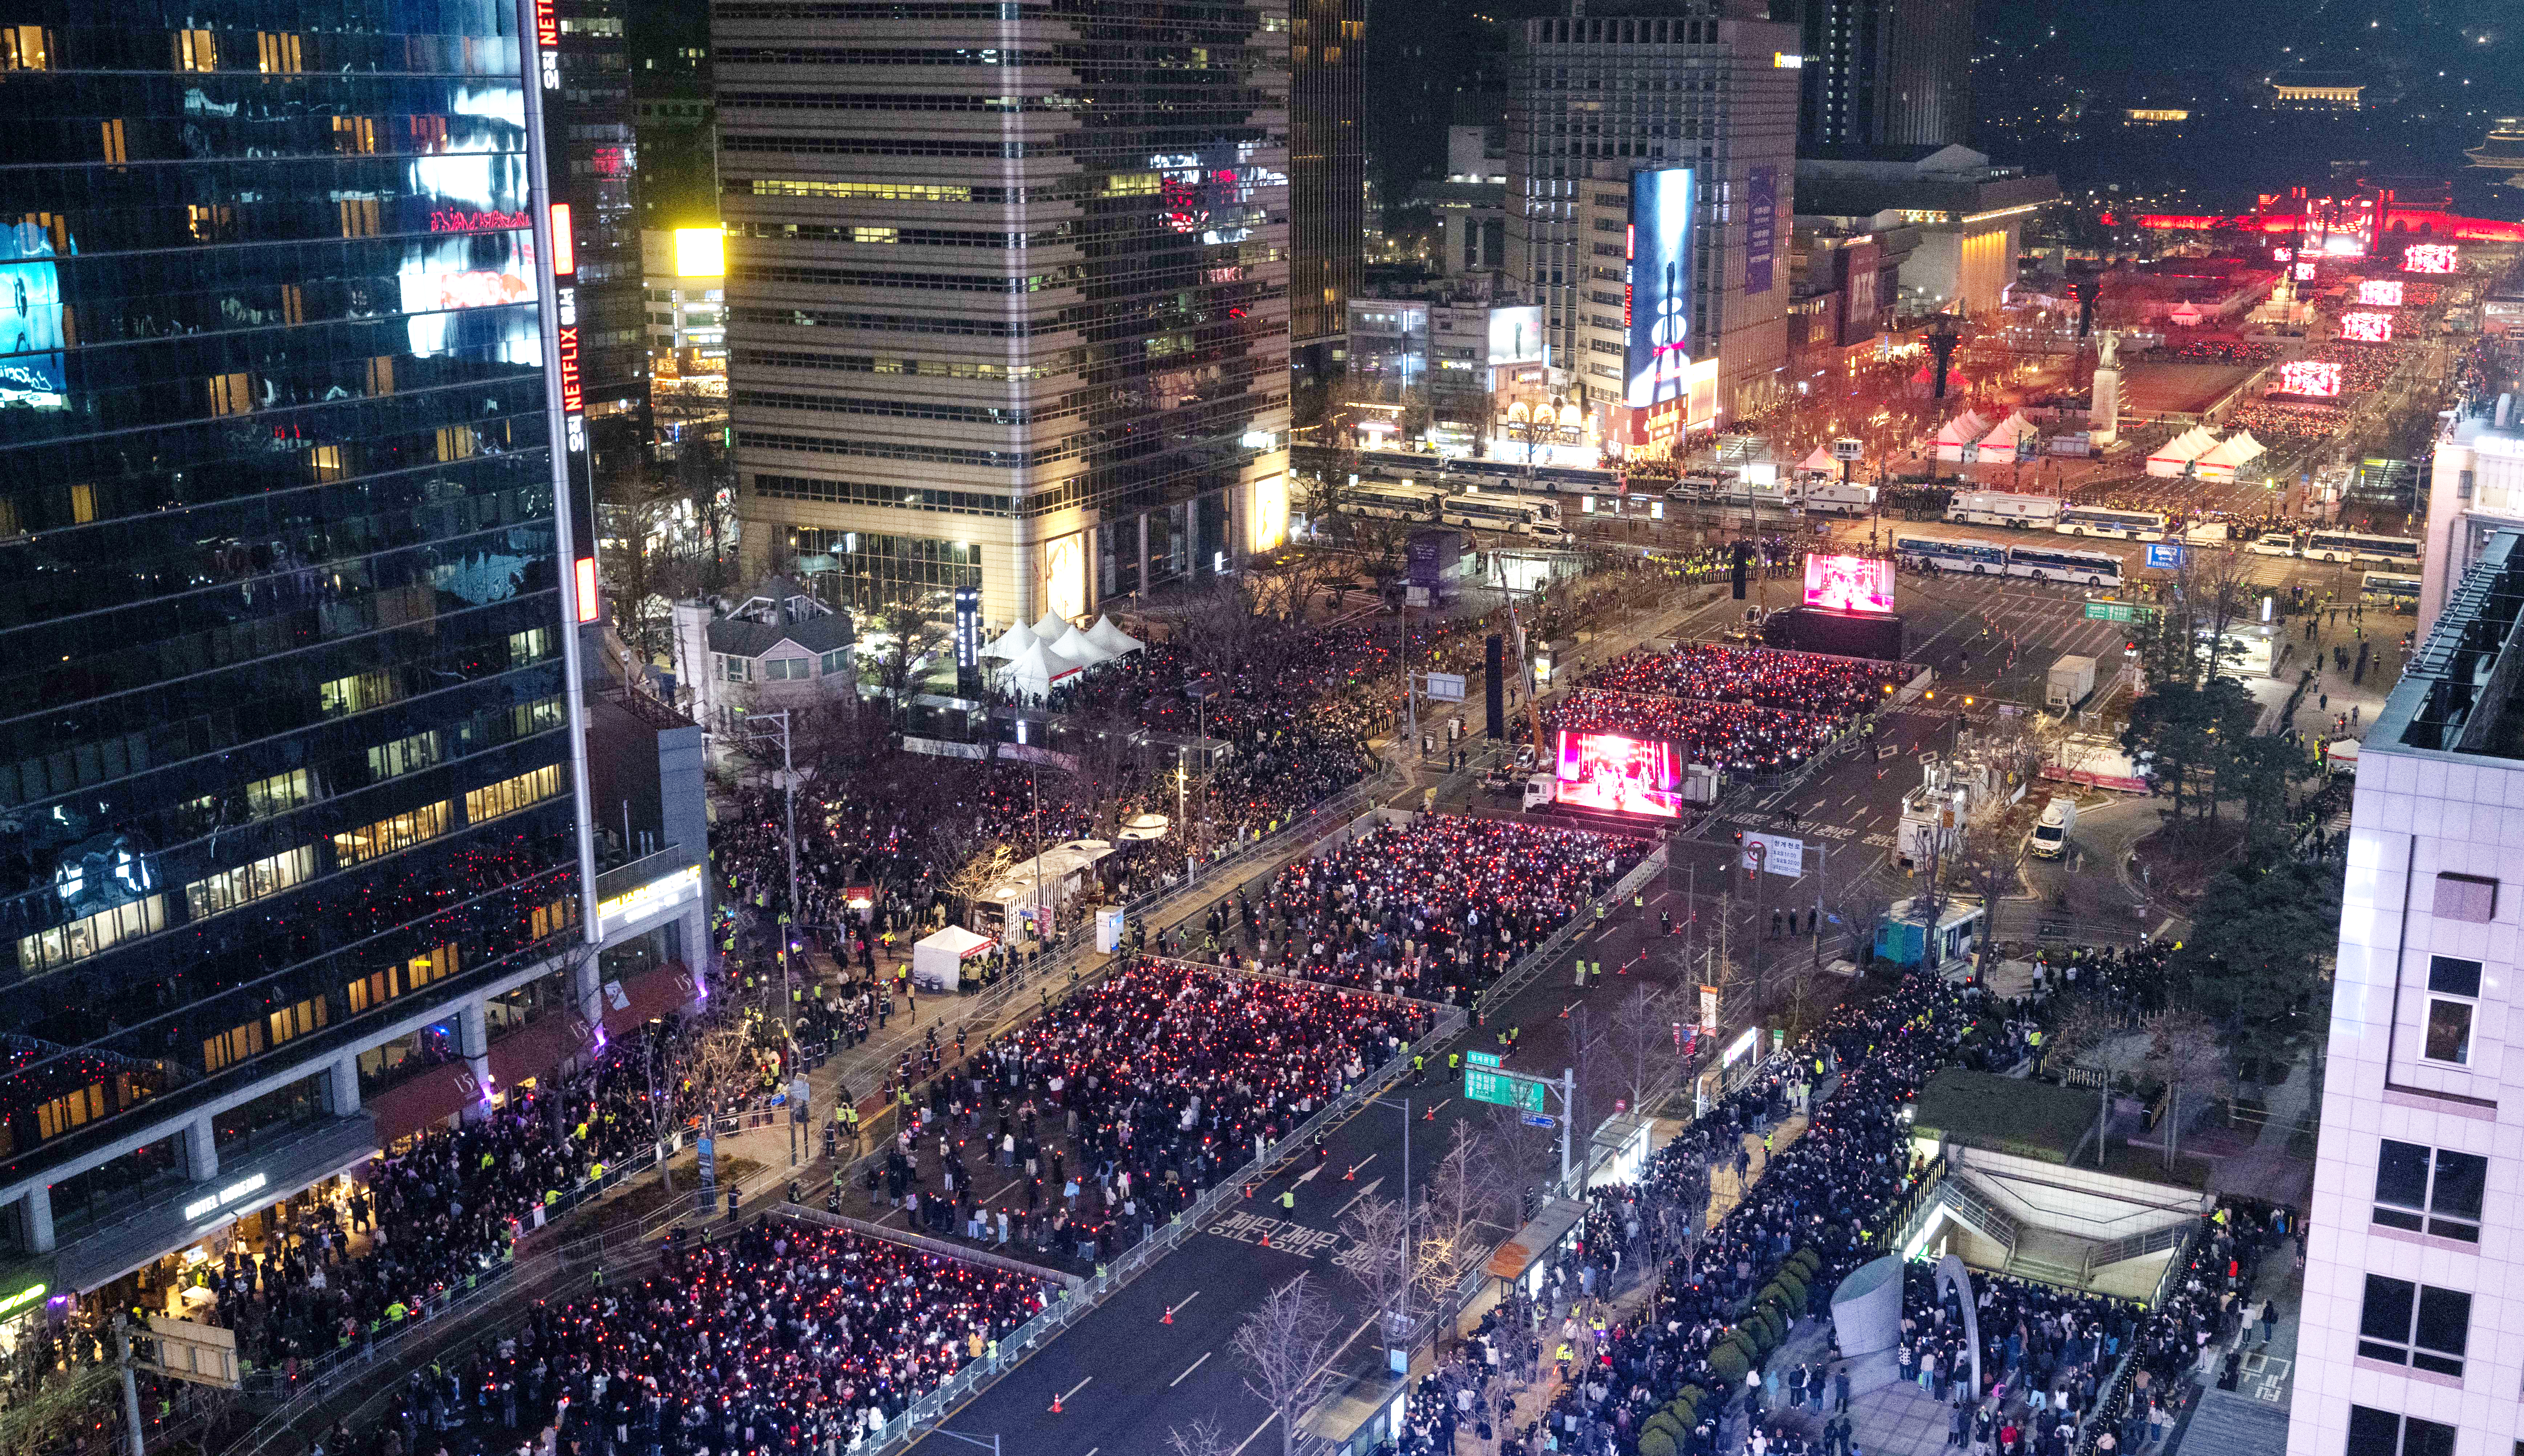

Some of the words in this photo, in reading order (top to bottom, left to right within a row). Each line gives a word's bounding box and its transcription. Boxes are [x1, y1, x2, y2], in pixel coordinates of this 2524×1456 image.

[542, 52, 559, 89] 오직
[559, 327, 583, 411] NETFLIX
[568, 415, 584, 452] 오직
[1774, 840, 1800, 849] 청계천로
[1471, 1054, 1496, 1065] 청계광장
[1476, 1074, 1496, 1085] 독립문
[1476, 1081, 1496, 1093] 광화문
[186, 1195, 219, 1221] HOTEL
[220, 1173, 266, 1205] KOREANA
